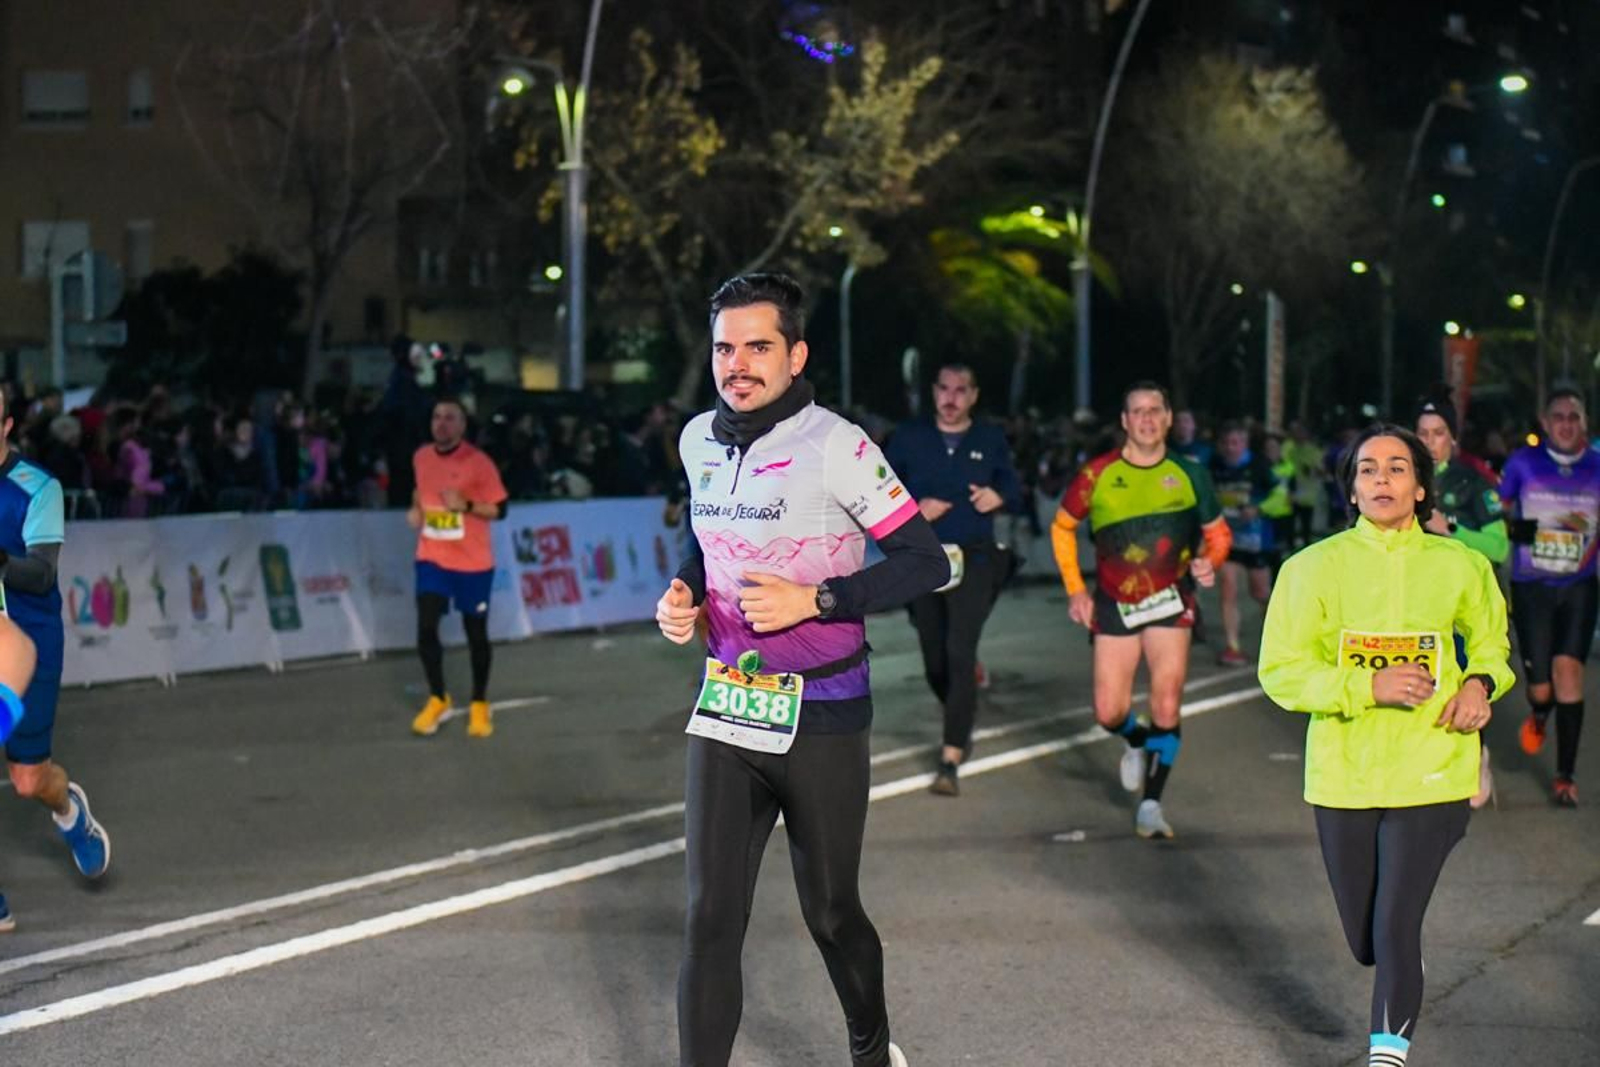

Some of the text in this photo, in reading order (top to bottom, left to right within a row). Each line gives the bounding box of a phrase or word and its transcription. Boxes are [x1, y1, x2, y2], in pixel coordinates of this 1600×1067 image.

[693, 502, 721, 517] ERRA
[731, 503, 781, 521] SEGURA
[1362, 636, 1382, 649] 42
[707, 682, 792, 725] 3038
